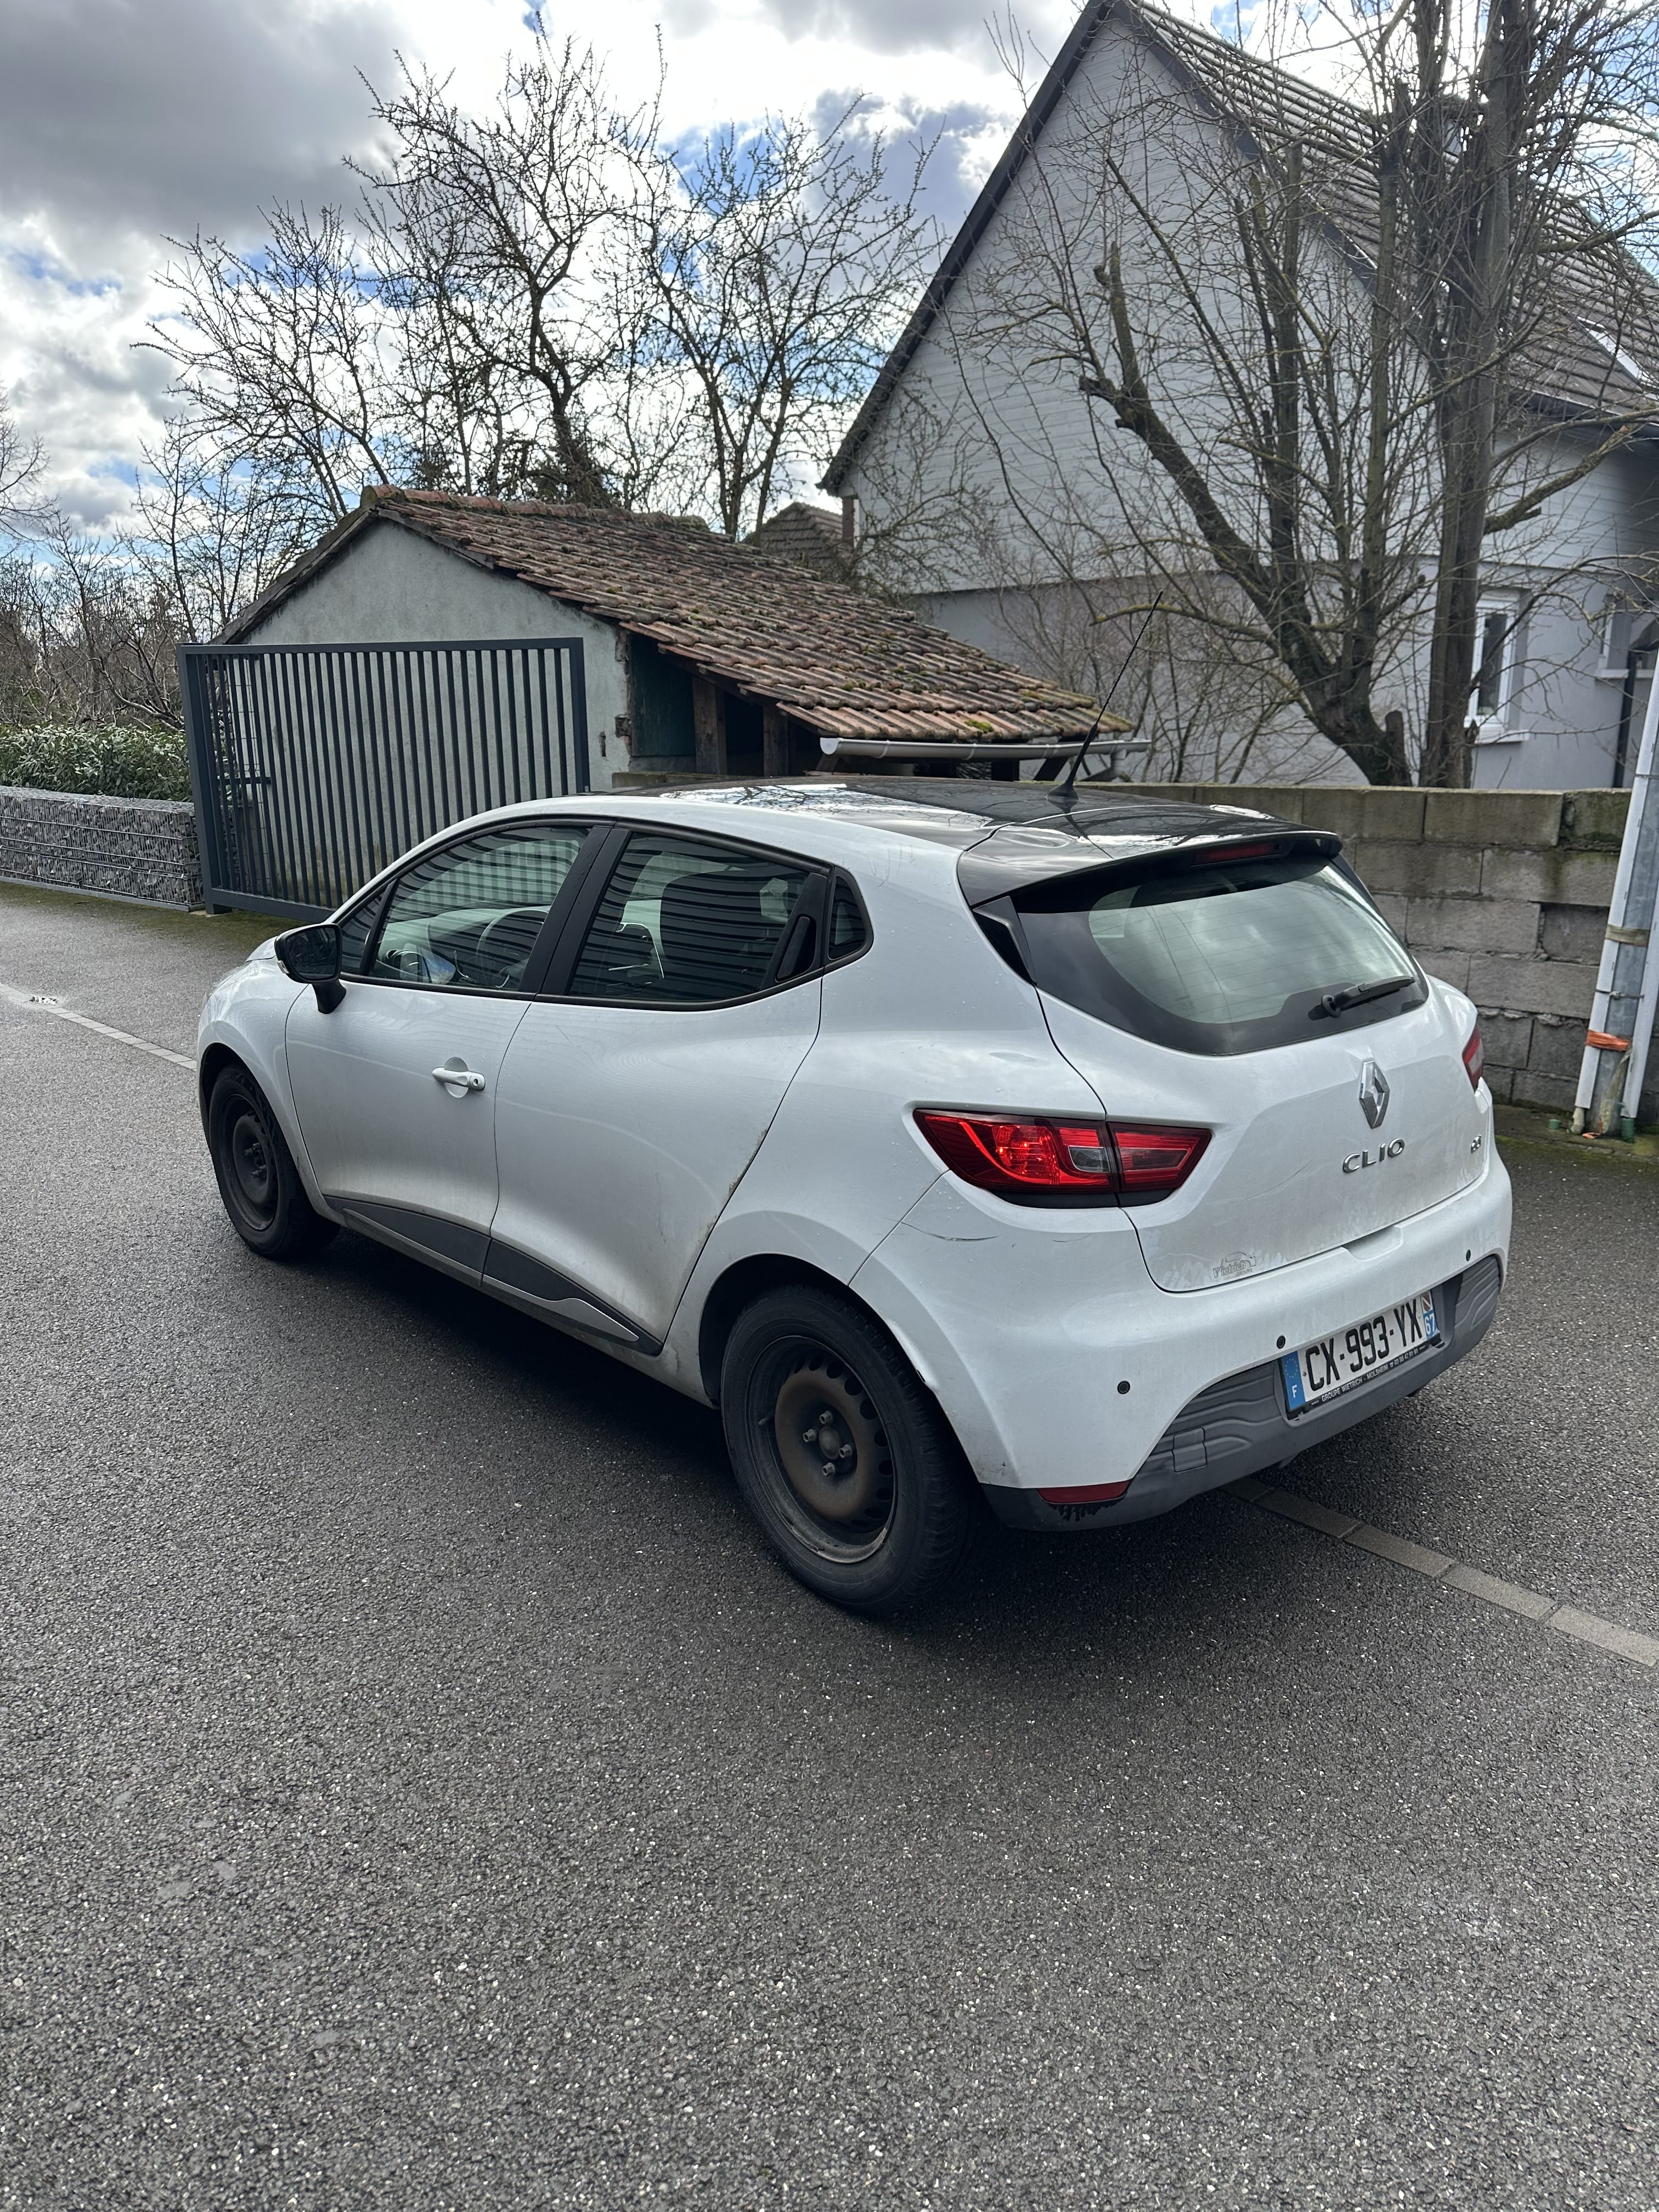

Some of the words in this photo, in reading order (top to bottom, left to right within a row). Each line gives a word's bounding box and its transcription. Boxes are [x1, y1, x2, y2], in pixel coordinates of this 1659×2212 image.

[1342, 1137, 1405, 1173] CLIO
[1425, 1313, 1435, 1335] 67
[1292, 1384, 1298, 1398] F
[1322, 1387, 1341, 1402] GROUPE
